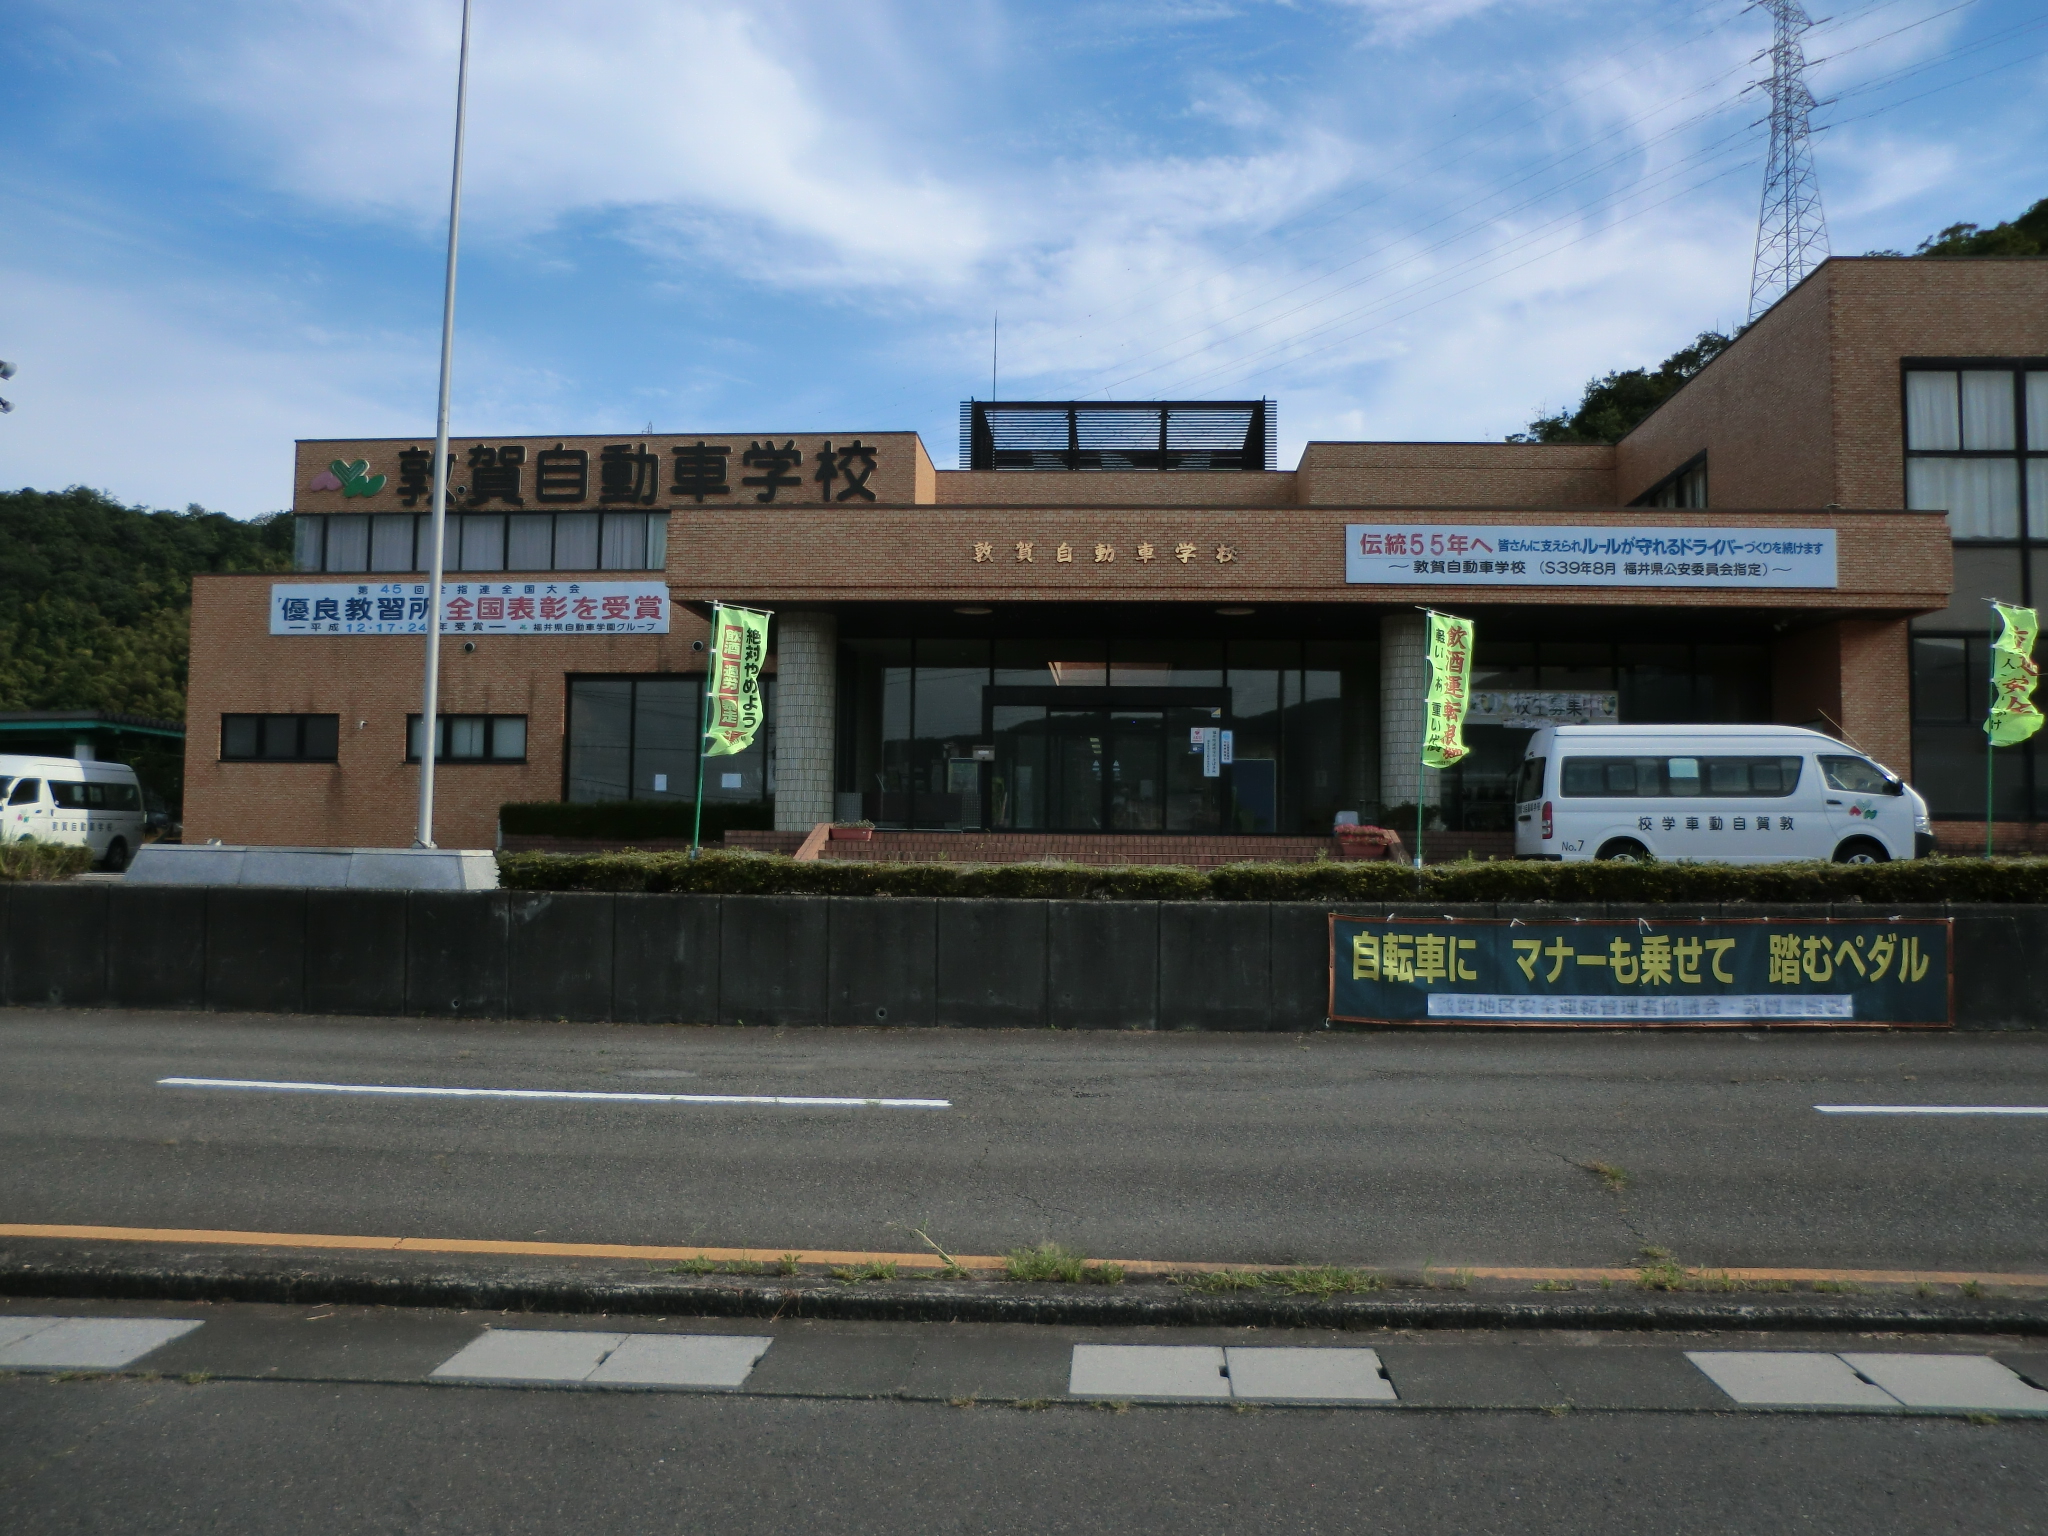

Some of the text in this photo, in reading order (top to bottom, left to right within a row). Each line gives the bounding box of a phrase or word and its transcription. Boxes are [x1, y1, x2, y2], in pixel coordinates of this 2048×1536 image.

[398, 440, 878, 507] 敦賀自動車学校
[973, 541, 1239, 564] 敦賀自動車学校
[1360, 533, 1494, 556] 伝統55年へ
[533, 622, 656, 632] 福井県自動車学園グループ
[742, 628, 762, 729] 絶対やめよう
[1561, 839, 1585, 853] No.7
[1351, 931, 1930, 987] 自転車に マナーも乗せて 踏むペダル
